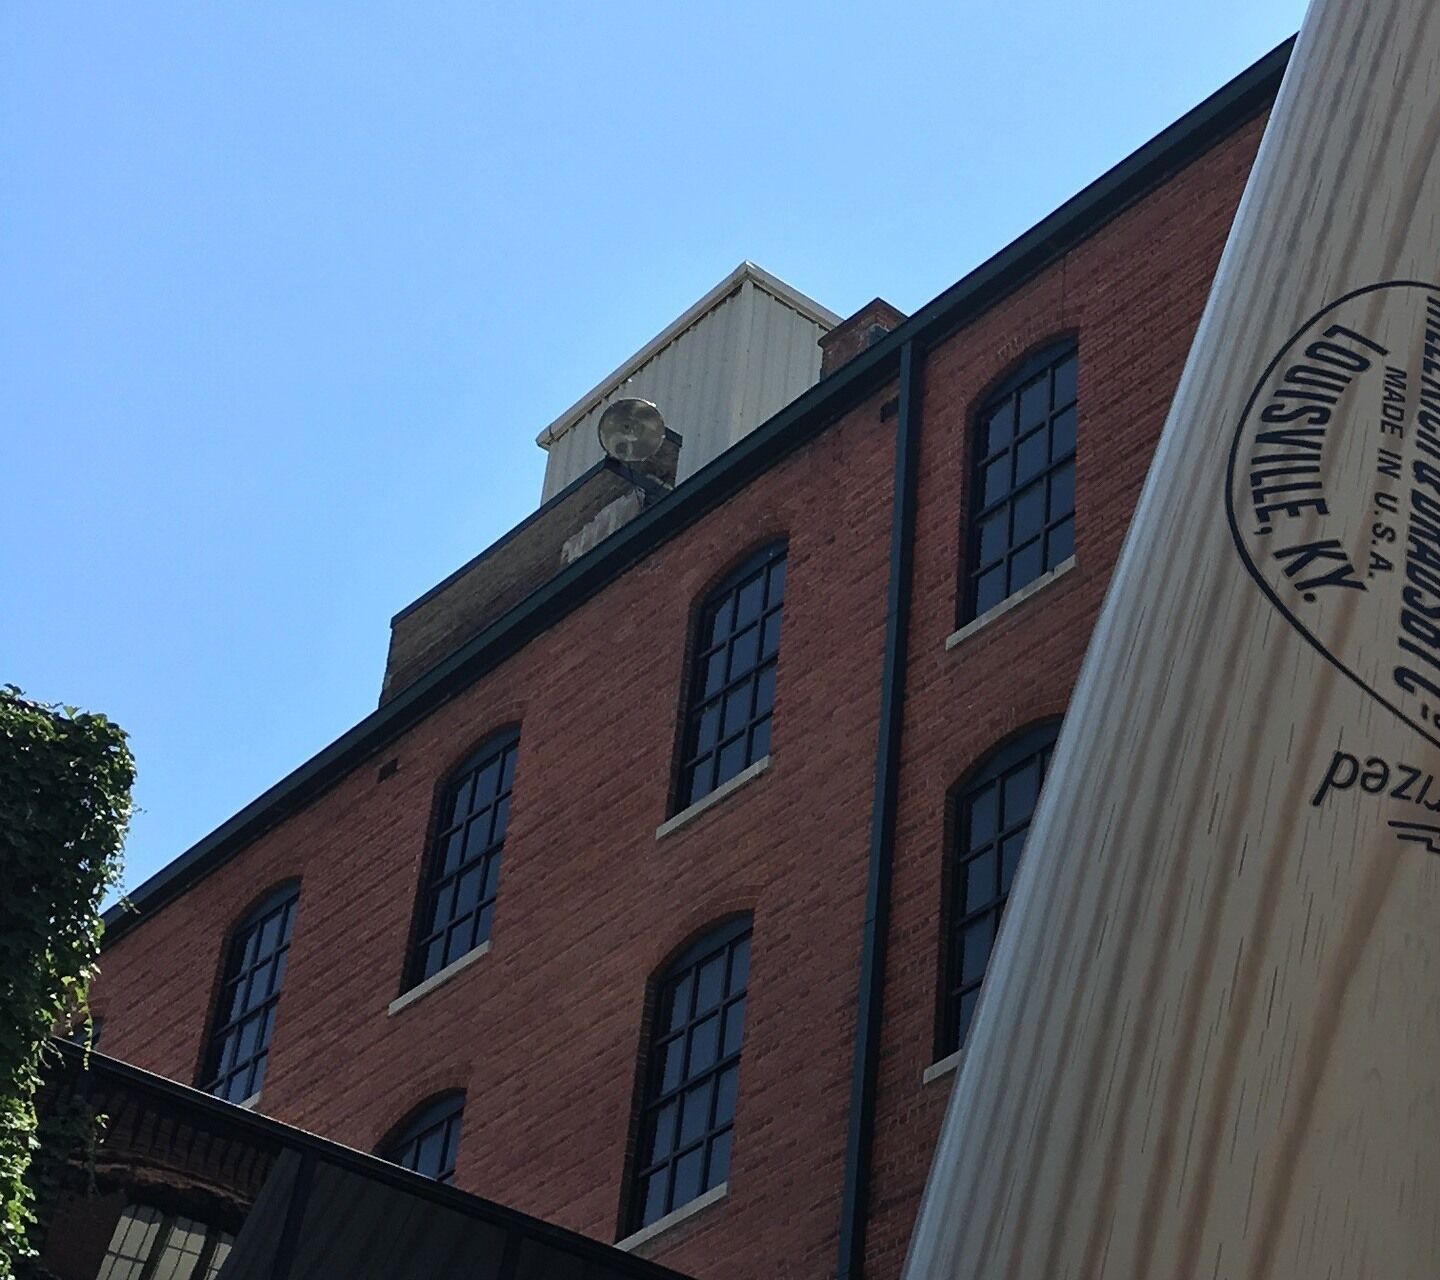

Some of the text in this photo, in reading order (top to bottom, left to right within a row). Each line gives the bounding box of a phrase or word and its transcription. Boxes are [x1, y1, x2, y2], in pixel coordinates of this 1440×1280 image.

[1379, 365, 1408, 440] MADE
[1249, 323, 1390, 603] LOUISVILLE, KY.
[1376, 447, 1403, 481] IN
